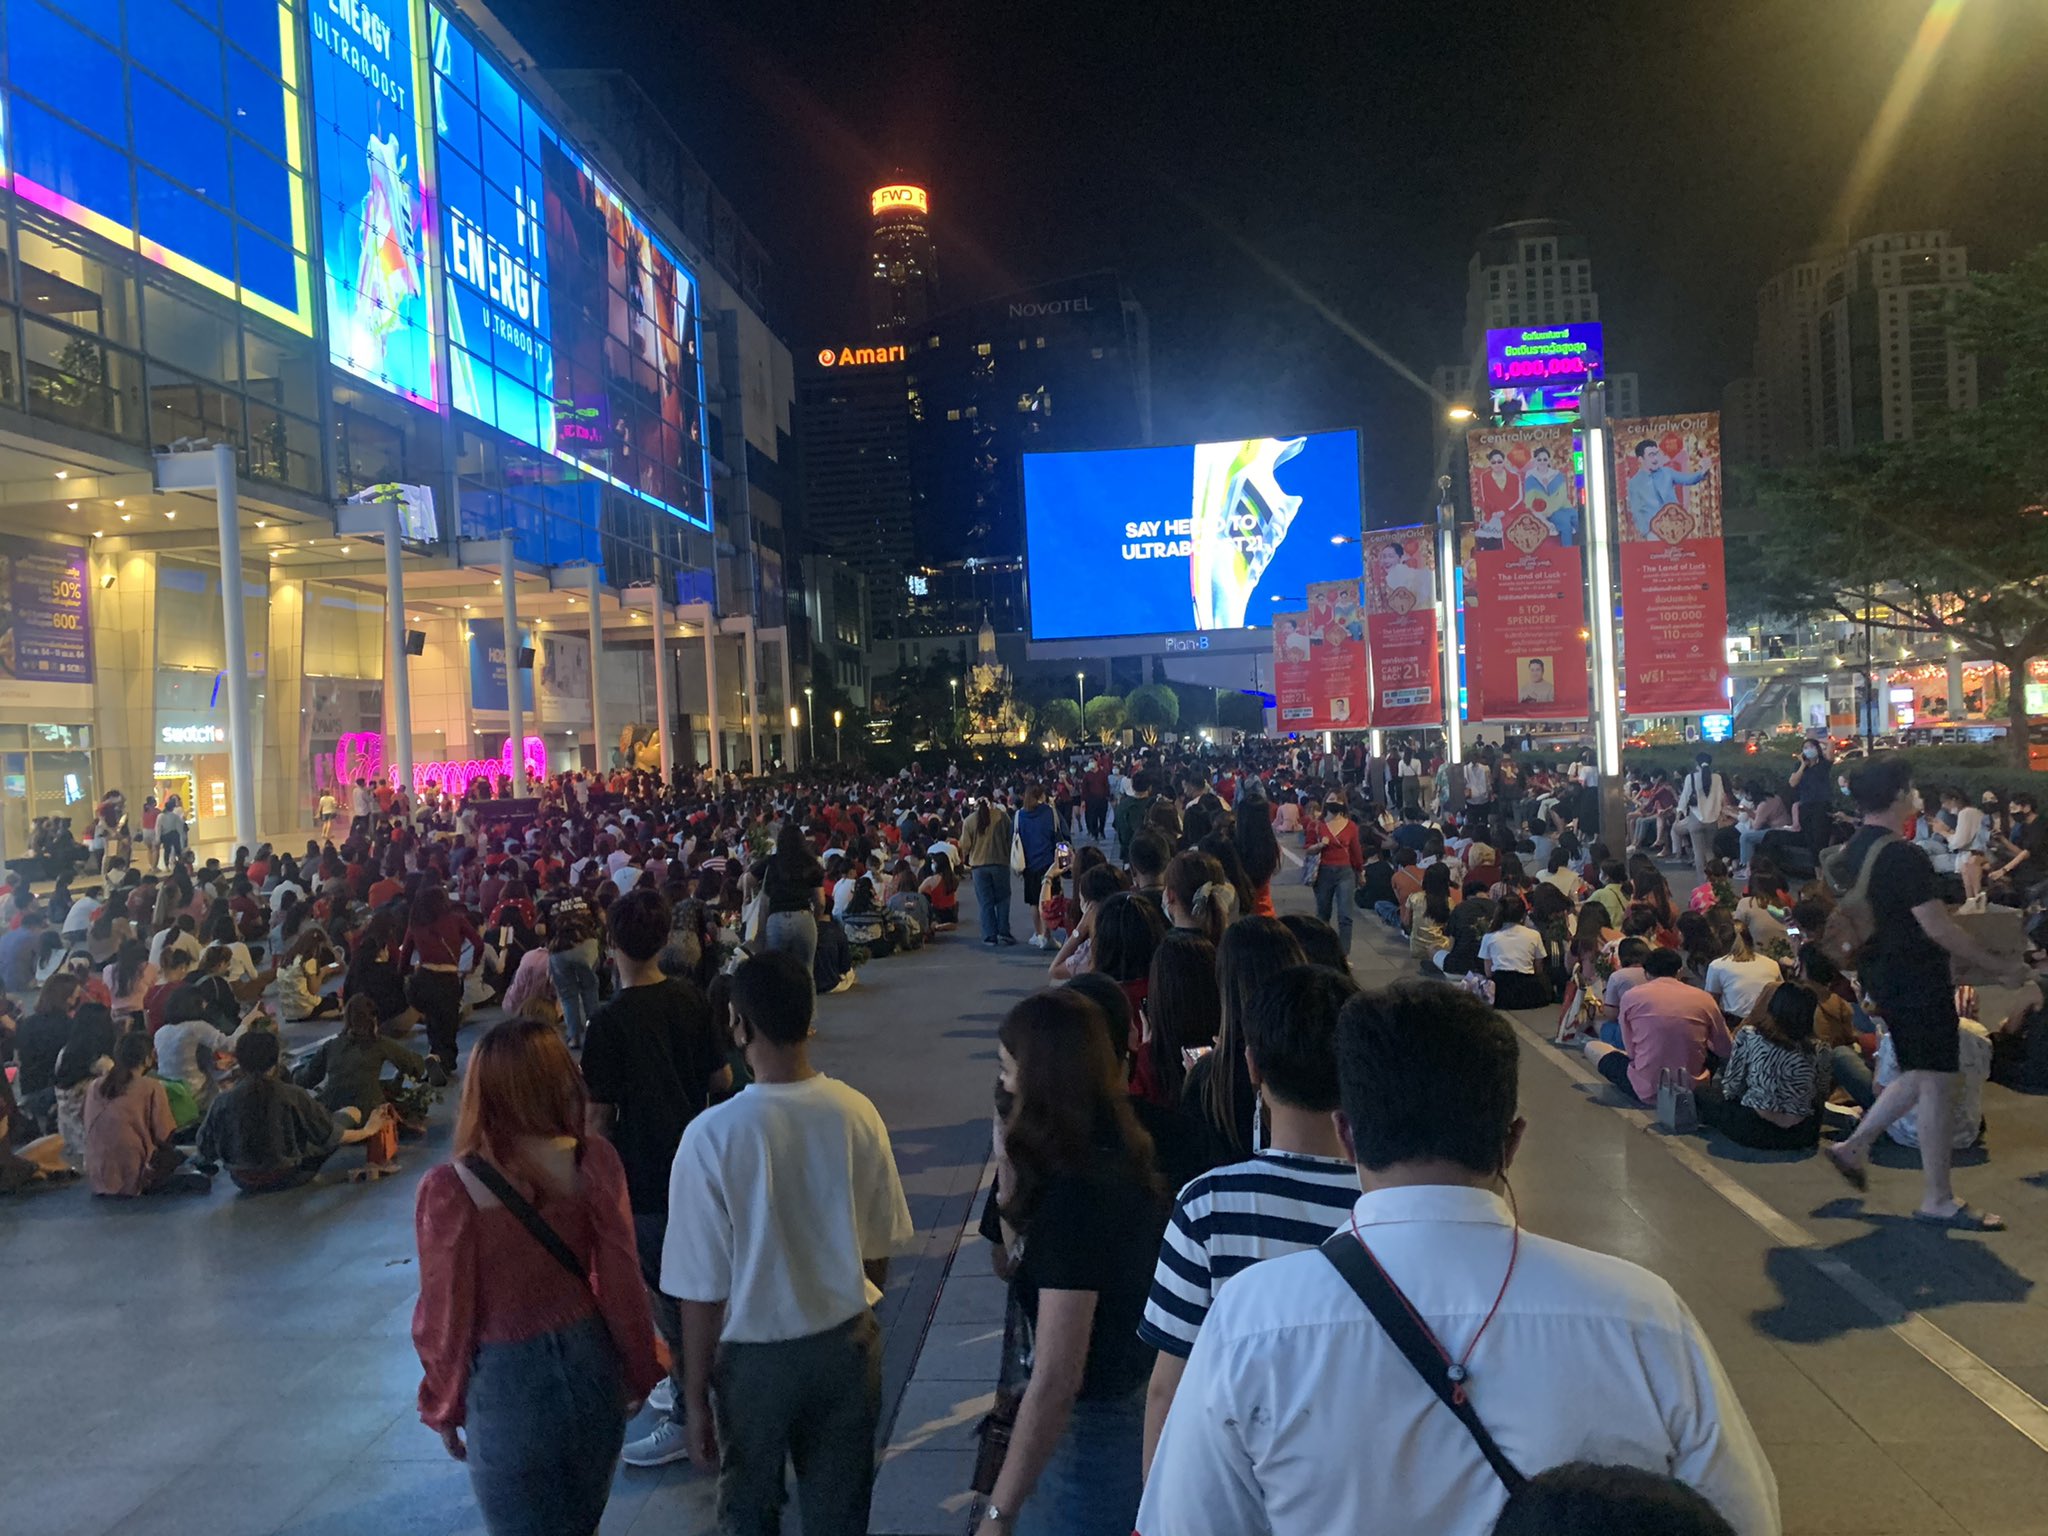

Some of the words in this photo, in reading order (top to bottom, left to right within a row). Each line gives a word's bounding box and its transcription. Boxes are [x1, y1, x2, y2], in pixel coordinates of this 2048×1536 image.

[313, 11, 405, 110] ULTRABOOST
[881, 189, 913, 203] FWD
[450, 205, 541, 329] ENERGY
[1008, 296, 1094, 318] NOVOTEL
[482, 306, 544, 363] UTRABOOT
[838, 345, 905, 366] Amari
[1125, 520, 1161, 539] SAY
[1164, 516, 1226, 537] HEO
[1230, 514, 1258, 531] TO
[1121, 535, 1263, 560] ULTRABT21
[1498, 573, 1513, 581] The
[1514, 572, 1534, 580] Land
[1642, 565, 1657, 573] The
[52, 580, 82, 599] 50%
[1527, 605, 1546, 614] TOP
[1381, 665, 1402, 674] CASH
[161, 724, 215, 743] swatch
